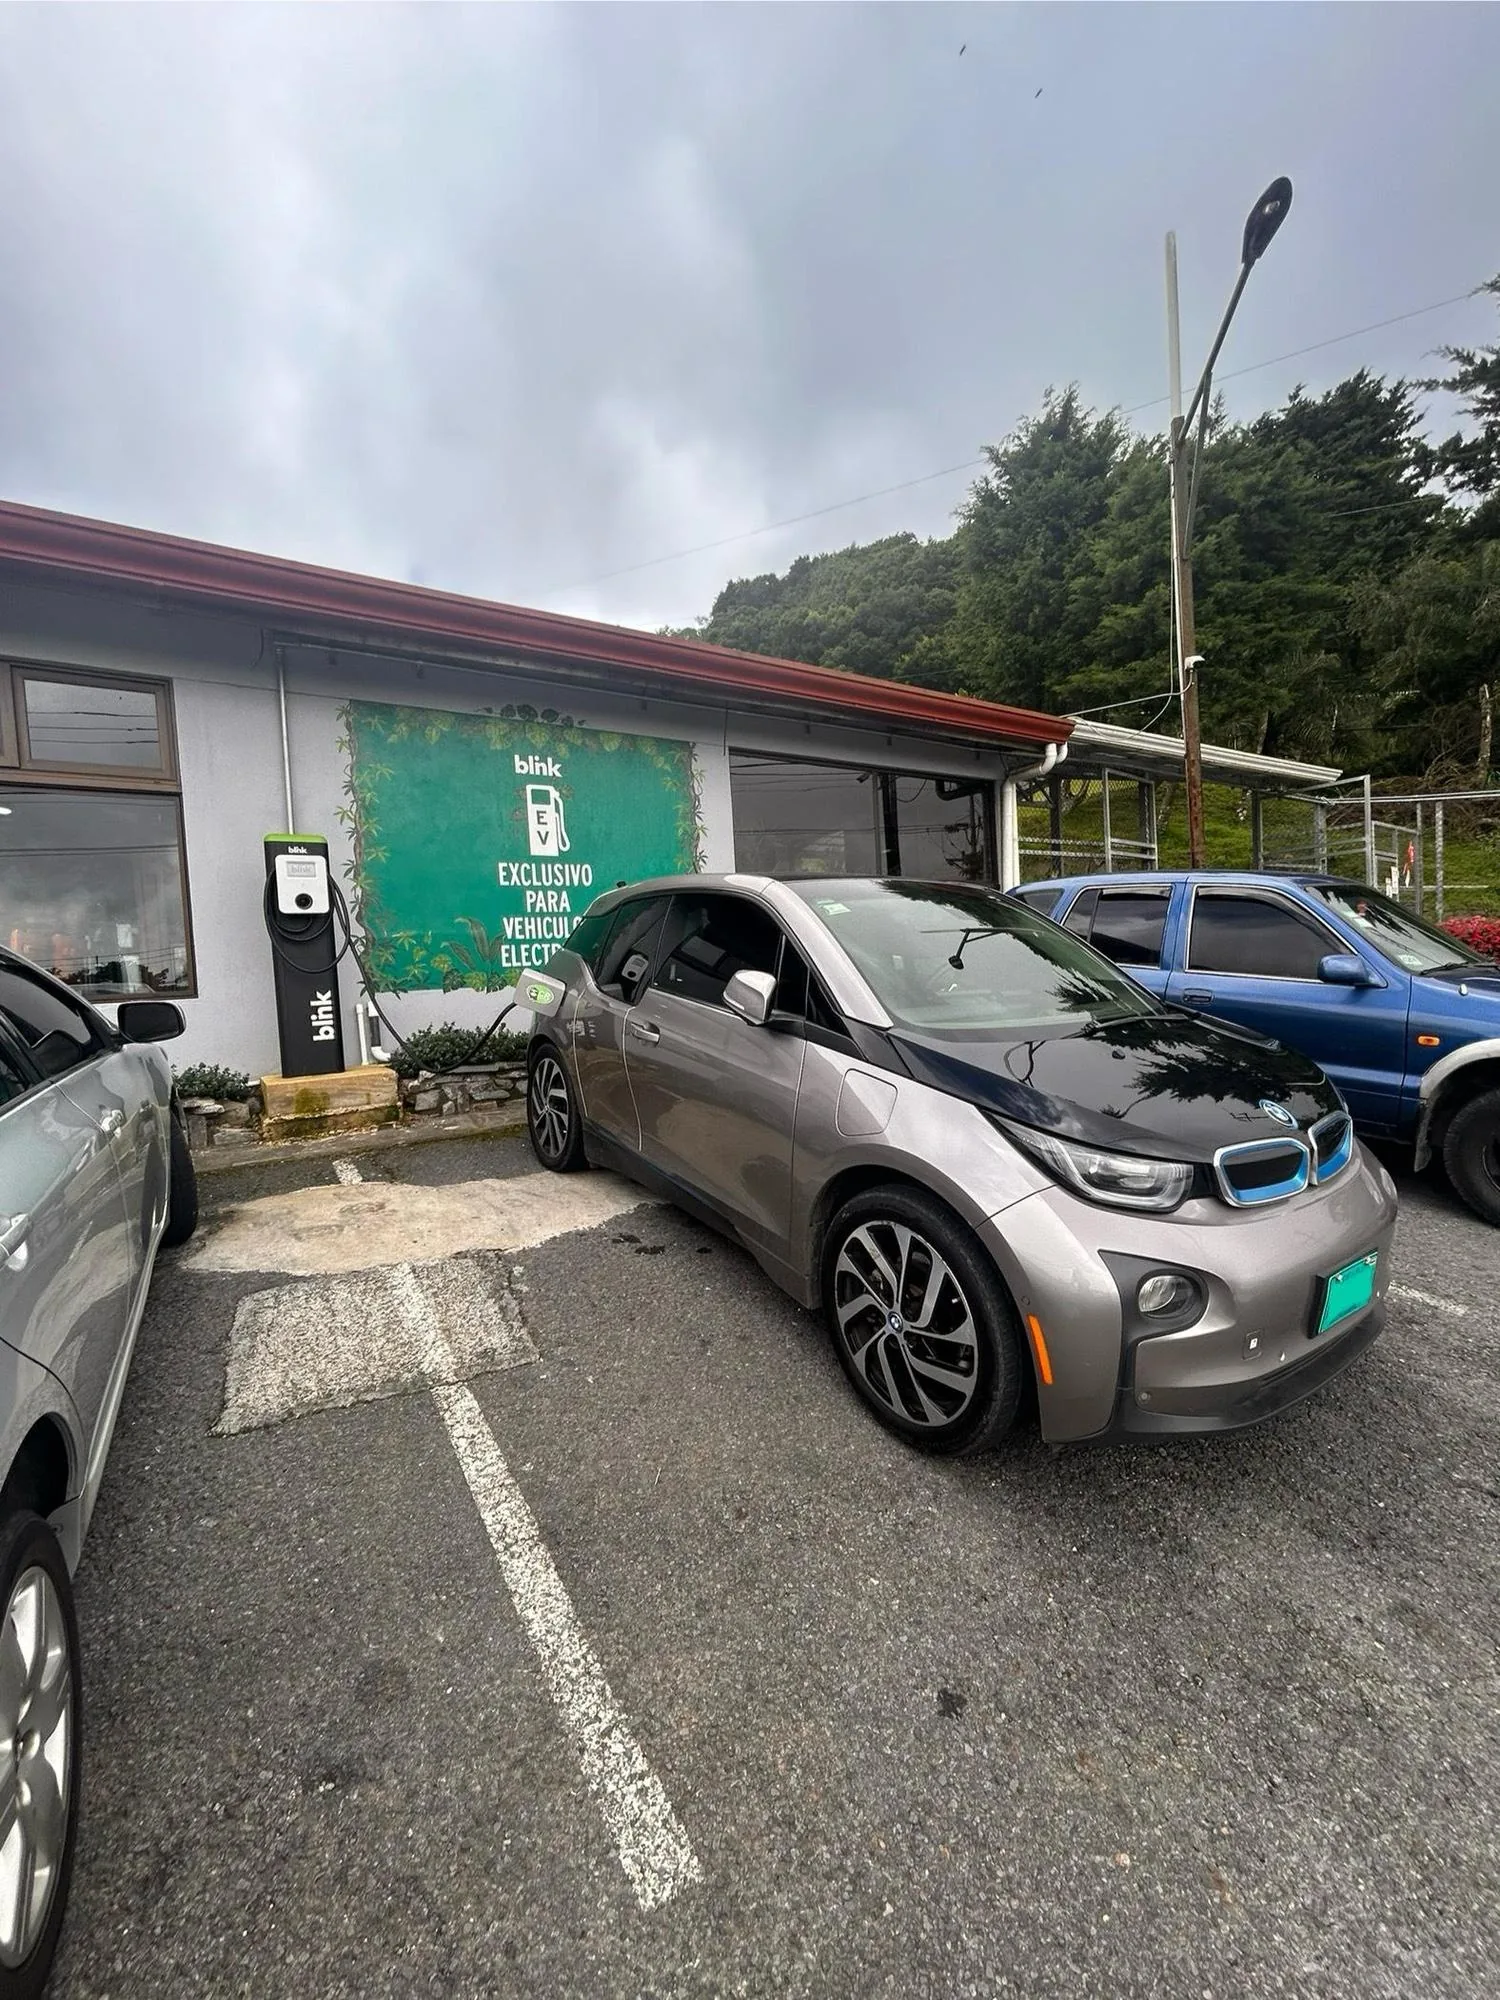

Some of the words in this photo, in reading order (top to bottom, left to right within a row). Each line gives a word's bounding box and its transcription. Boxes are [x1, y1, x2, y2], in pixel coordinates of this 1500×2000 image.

[514, 755, 562, 777] blink
[288, 846, 308, 854] blink
[498, 862, 593, 887] EXCLUSIVO
[526, 890, 571, 912] PARA
[310, 989, 335, 1041] blink
